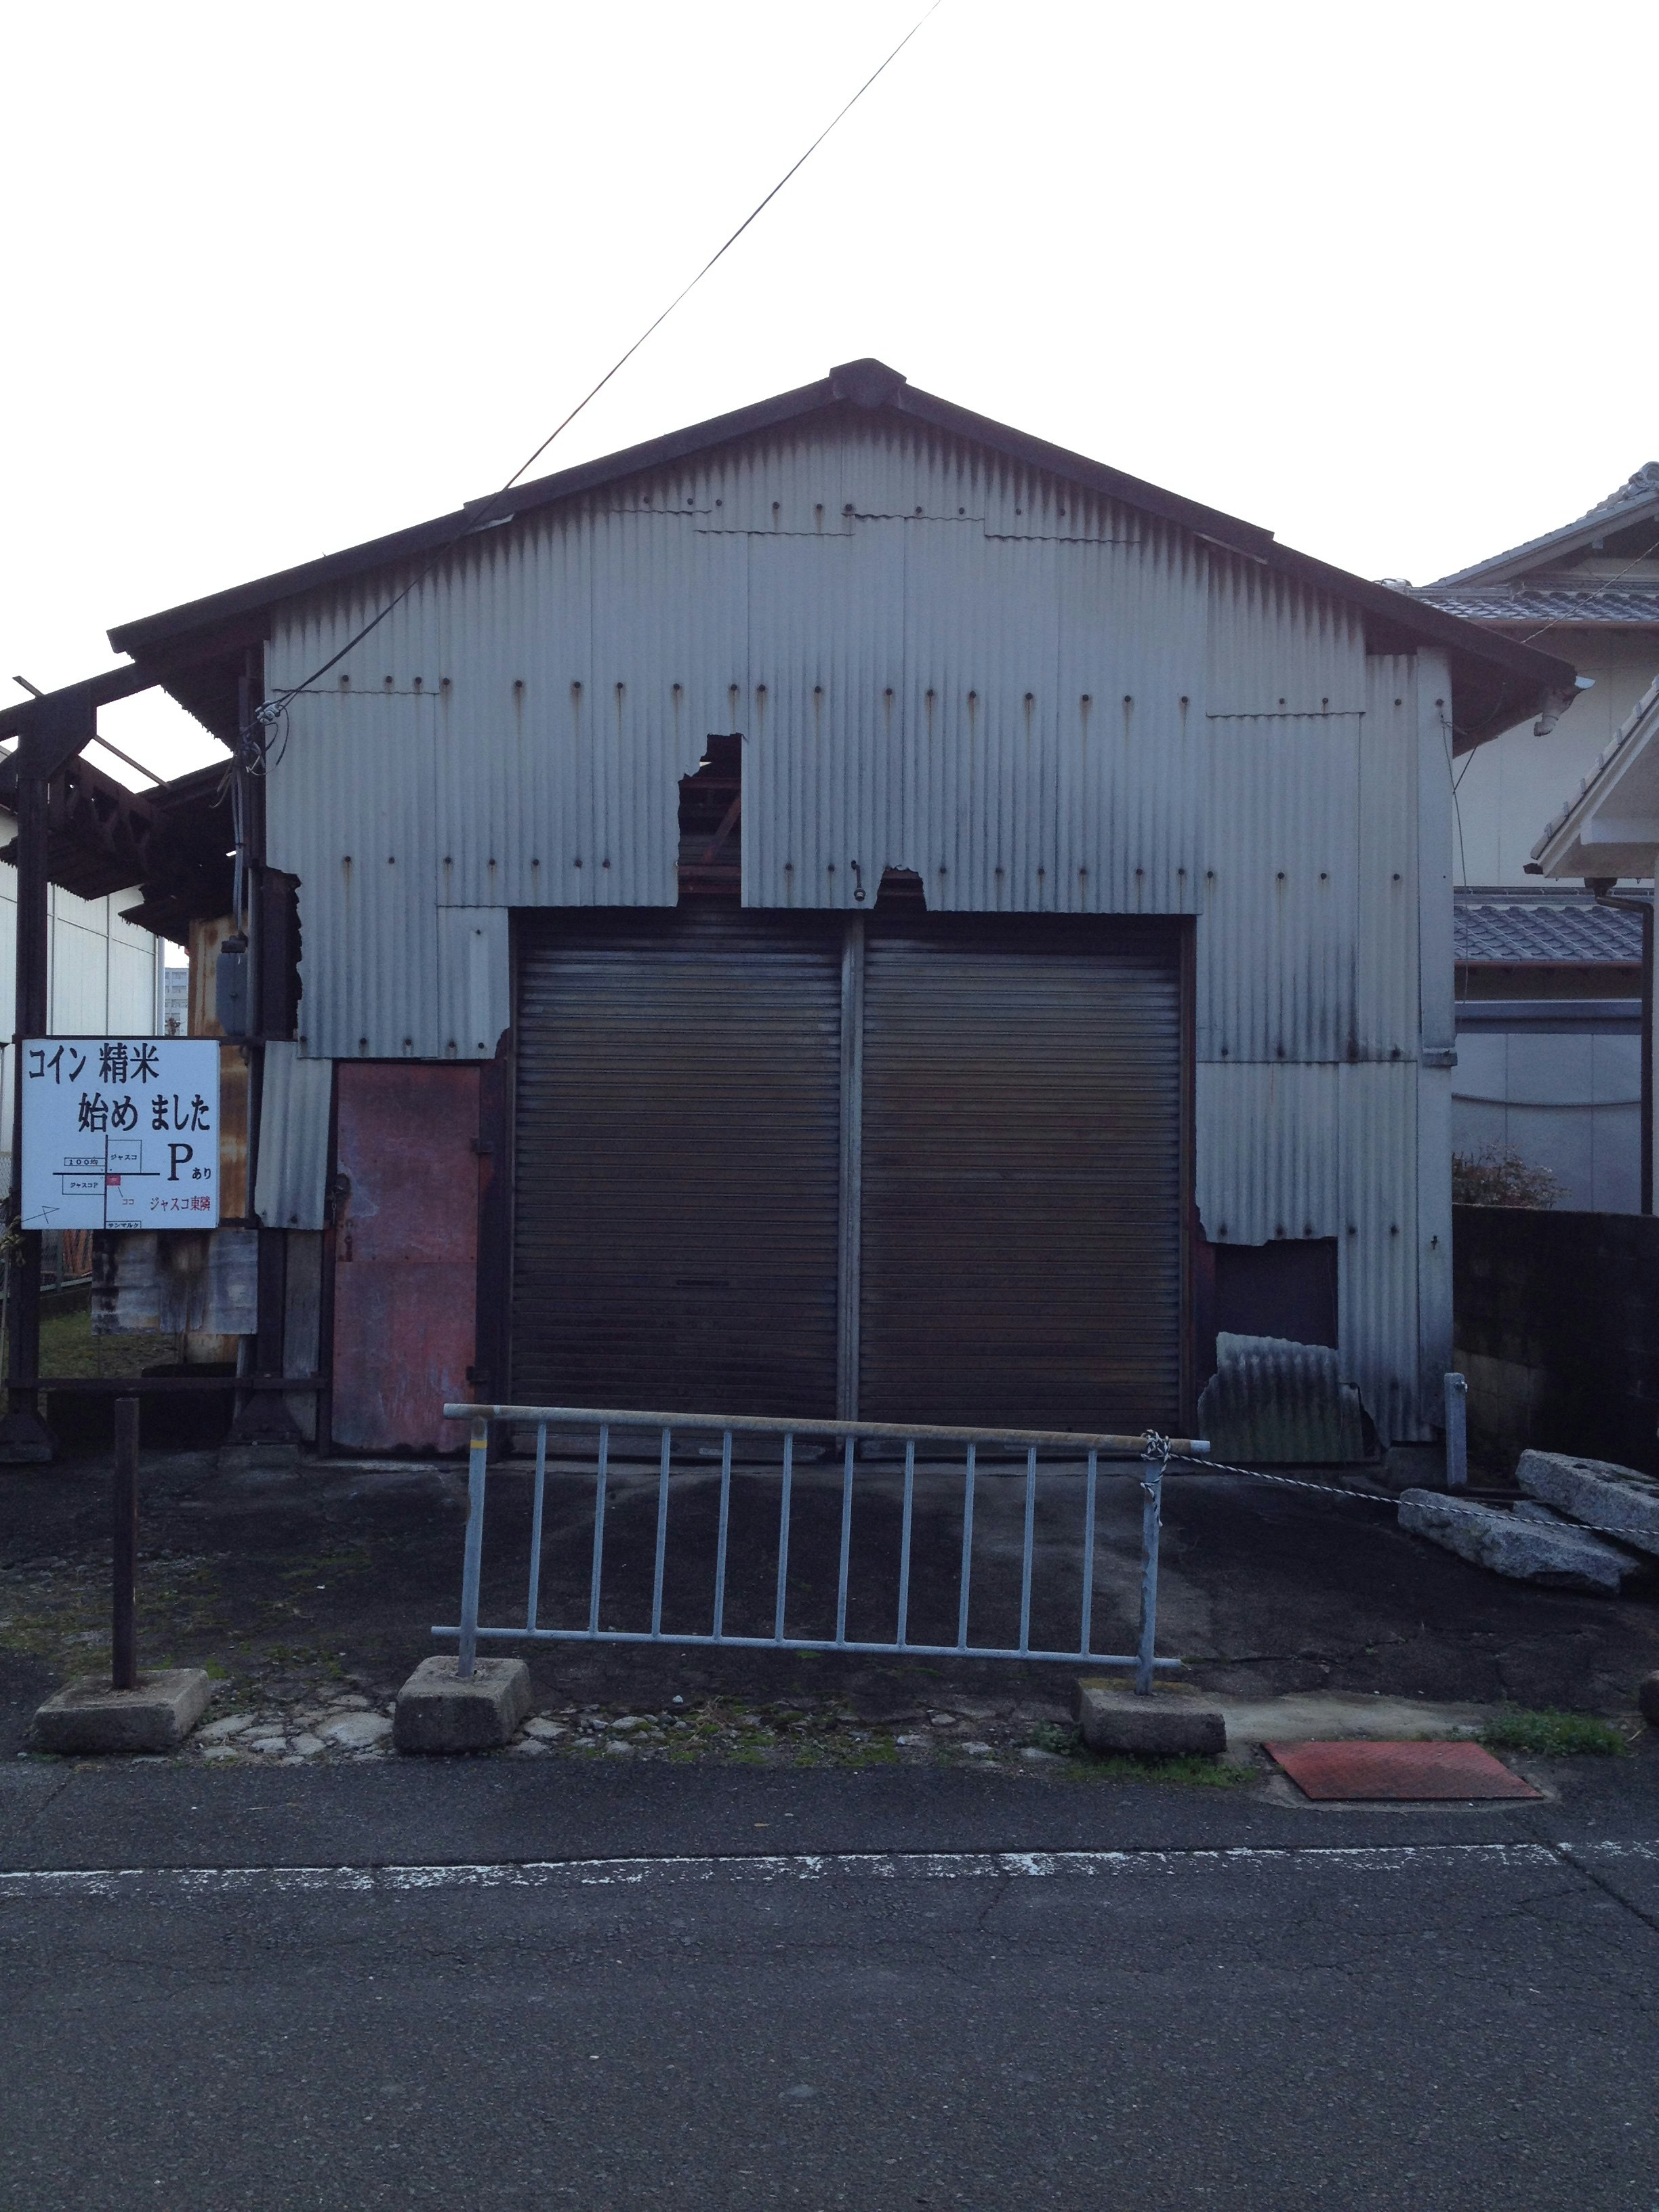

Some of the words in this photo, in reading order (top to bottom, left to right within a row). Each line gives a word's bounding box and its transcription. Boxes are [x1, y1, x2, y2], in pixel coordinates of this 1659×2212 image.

[29, 1045, 86, 1084] コイン
[99, 1043, 159, 1084] 精米
[79, 1092, 138, 1132] 始め
[151, 1094, 210, 1132] ました
[167, 1143, 193, 1181] P
[192, 1167, 211, 1180] あり
[150, 1195, 211, 1212] ジャスコ東隣
